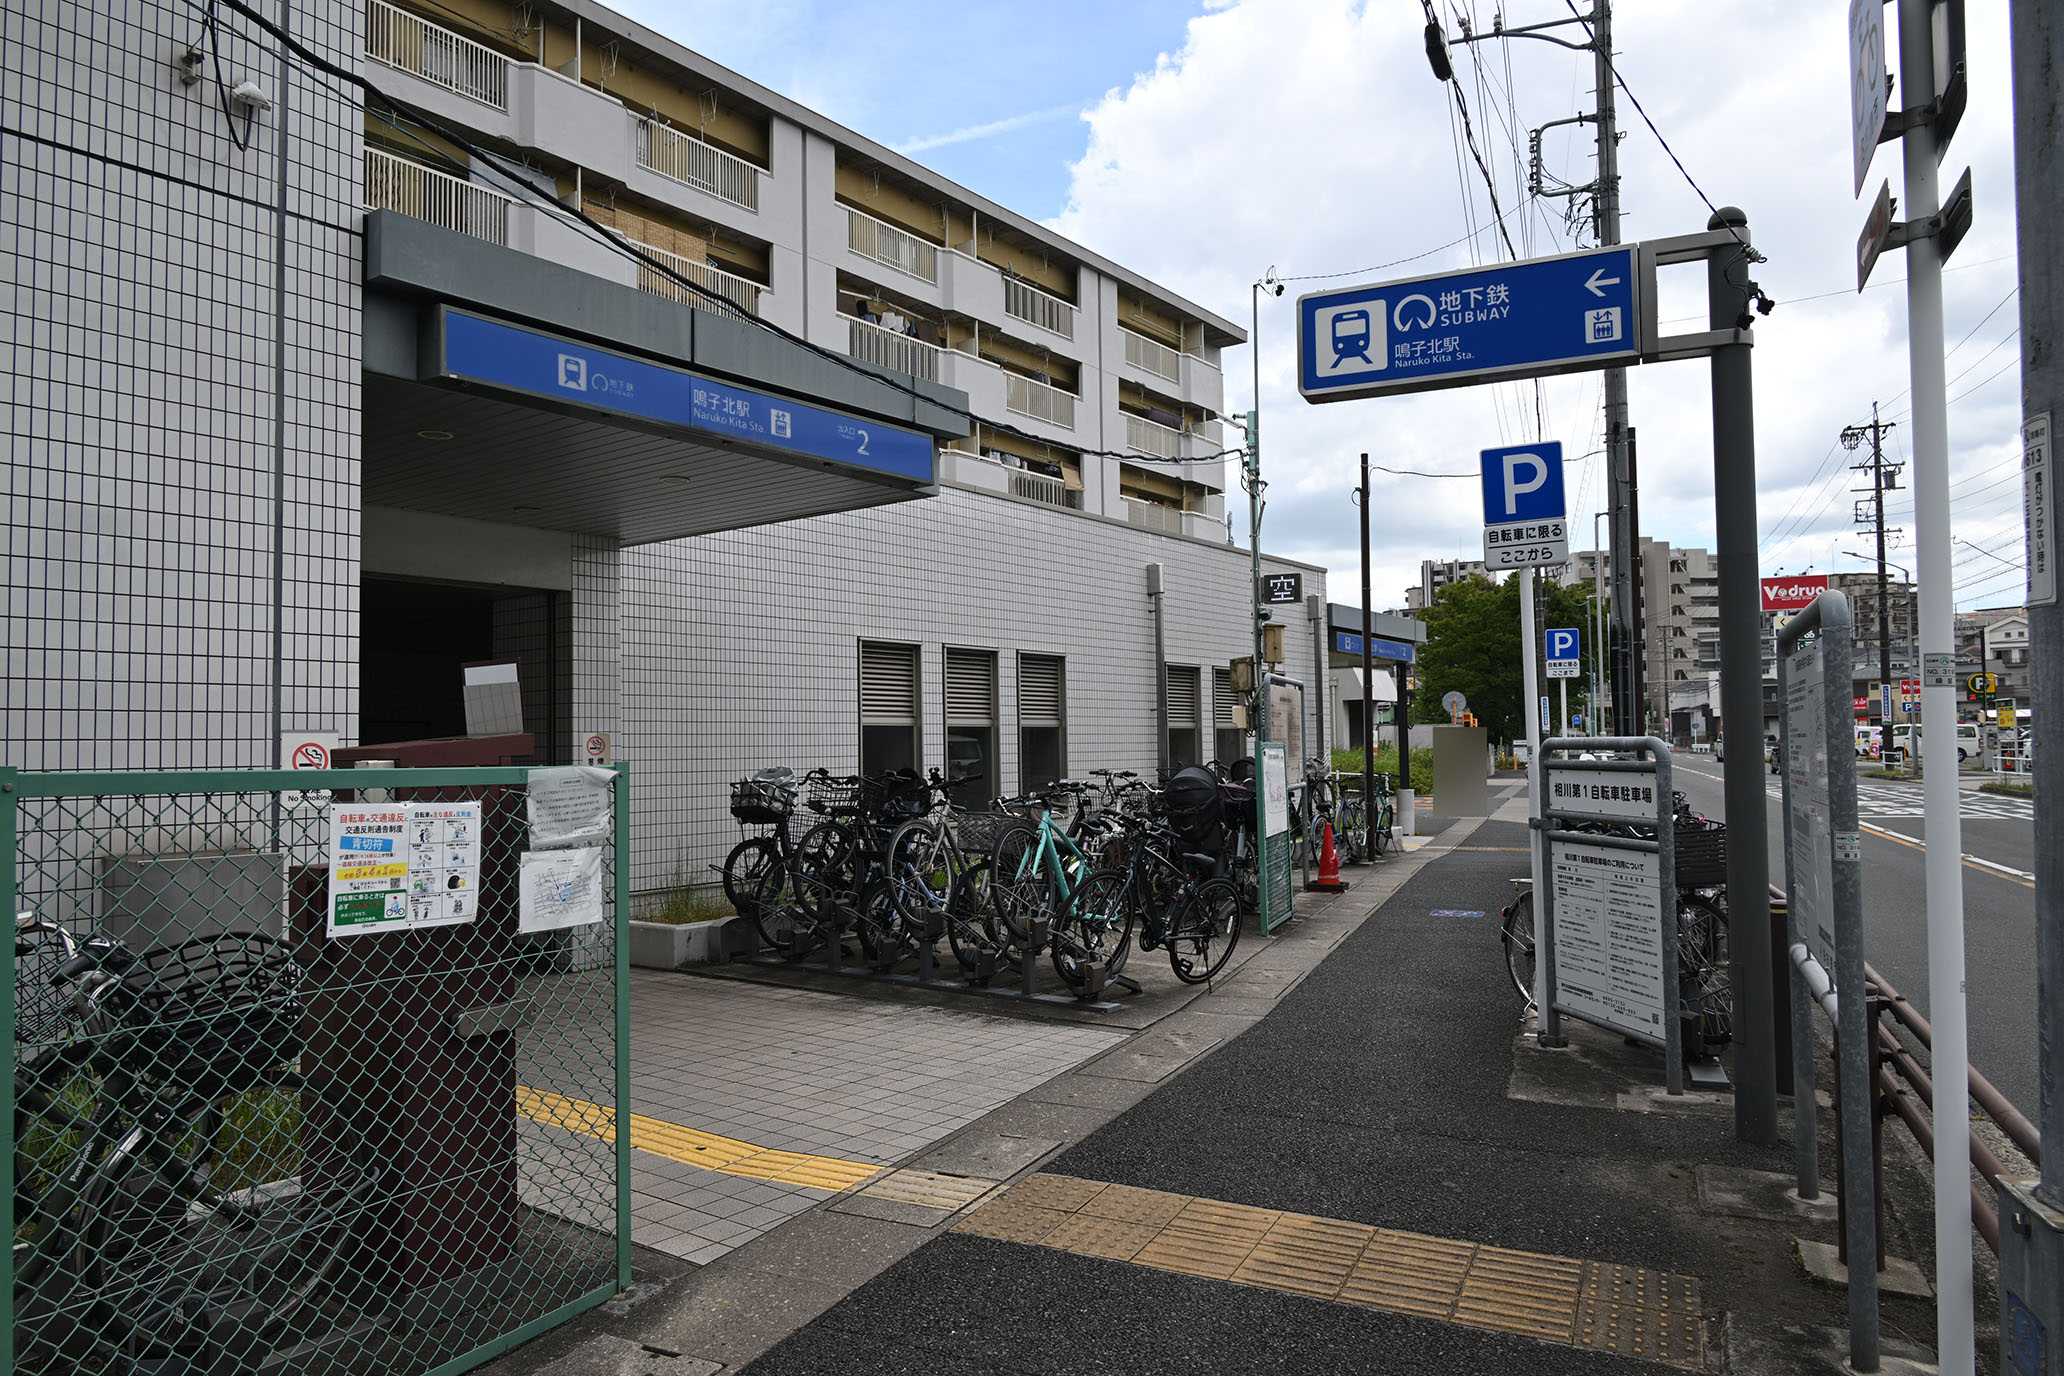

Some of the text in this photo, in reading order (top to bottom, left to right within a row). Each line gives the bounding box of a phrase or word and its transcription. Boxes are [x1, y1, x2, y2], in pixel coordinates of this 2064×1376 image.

[1440, 283, 1510, 311] 地下鉄
[1440, 306, 1510, 326] SUBWAY
[1394, 336, 1460, 359] 鳴子北駅
[1394, 351, 1475, 368] Naruko Kita Sta.
[609, 378, 634, 393] 地下鉄
[693, 388, 751, 418] 鳴子北駅
[693, 408, 728, 425] Naruko
[729, 416, 747, 430] Kita
[857, 429, 870, 456] 2
[1502, 453, 1548, 515] P
[1488, 523, 1563, 544] 自転車に限る
[1500, 547, 1553, 564] ここから
[1270, 576, 1295, 601] 空
[1554, 632, 1574, 657] P
[1548, 661, 1578, 669] 自転車に限る
[1552, 669, 1574, 677] ここまで
[1554, 782, 1653, 804] 相川第1自転車駐車場
[340, 812, 408, 825] 自転車の交通違反に
[345, 825, 403, 836] 交通反則通告制度
[351, 837, 383, 851] 青切符
